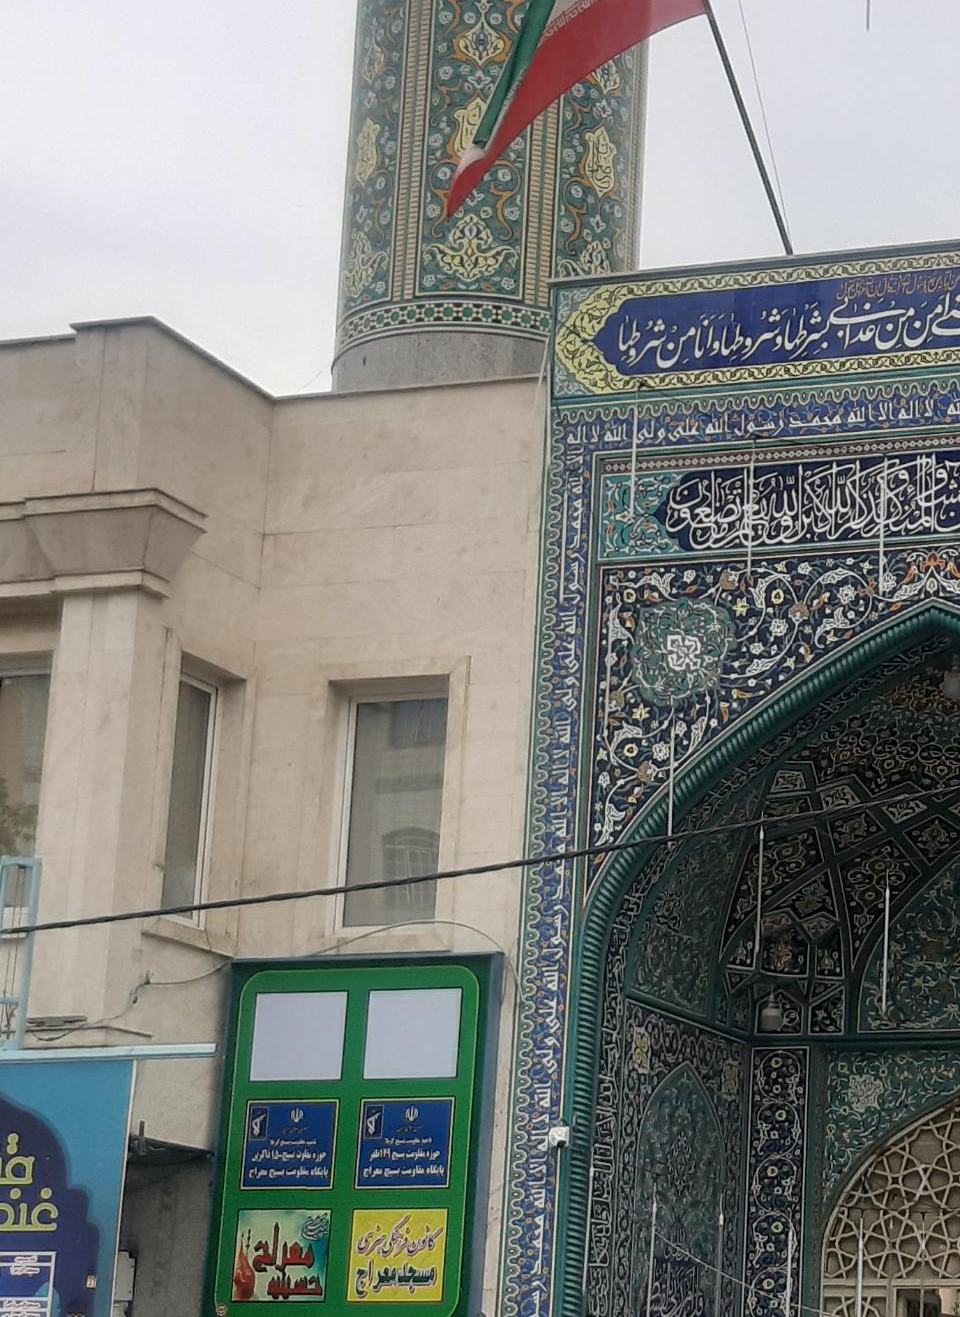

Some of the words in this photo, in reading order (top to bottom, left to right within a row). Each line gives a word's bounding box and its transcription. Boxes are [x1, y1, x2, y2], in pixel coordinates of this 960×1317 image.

[847, 402, 875, 424] الله
[879, 401, 895, 421] الا
[898, 399, 921, 419] اله
[924, 398, 934, 418] لا
[705, 411, 732, 435] الله
[735, 413, 785, 438] رسول
[788, 414, 842, 428] محمد
[604, 423, 627, 442] الله
[355, 1259, 397, 1299] معراج
[397, 1261, 438, 1294] مسجد
